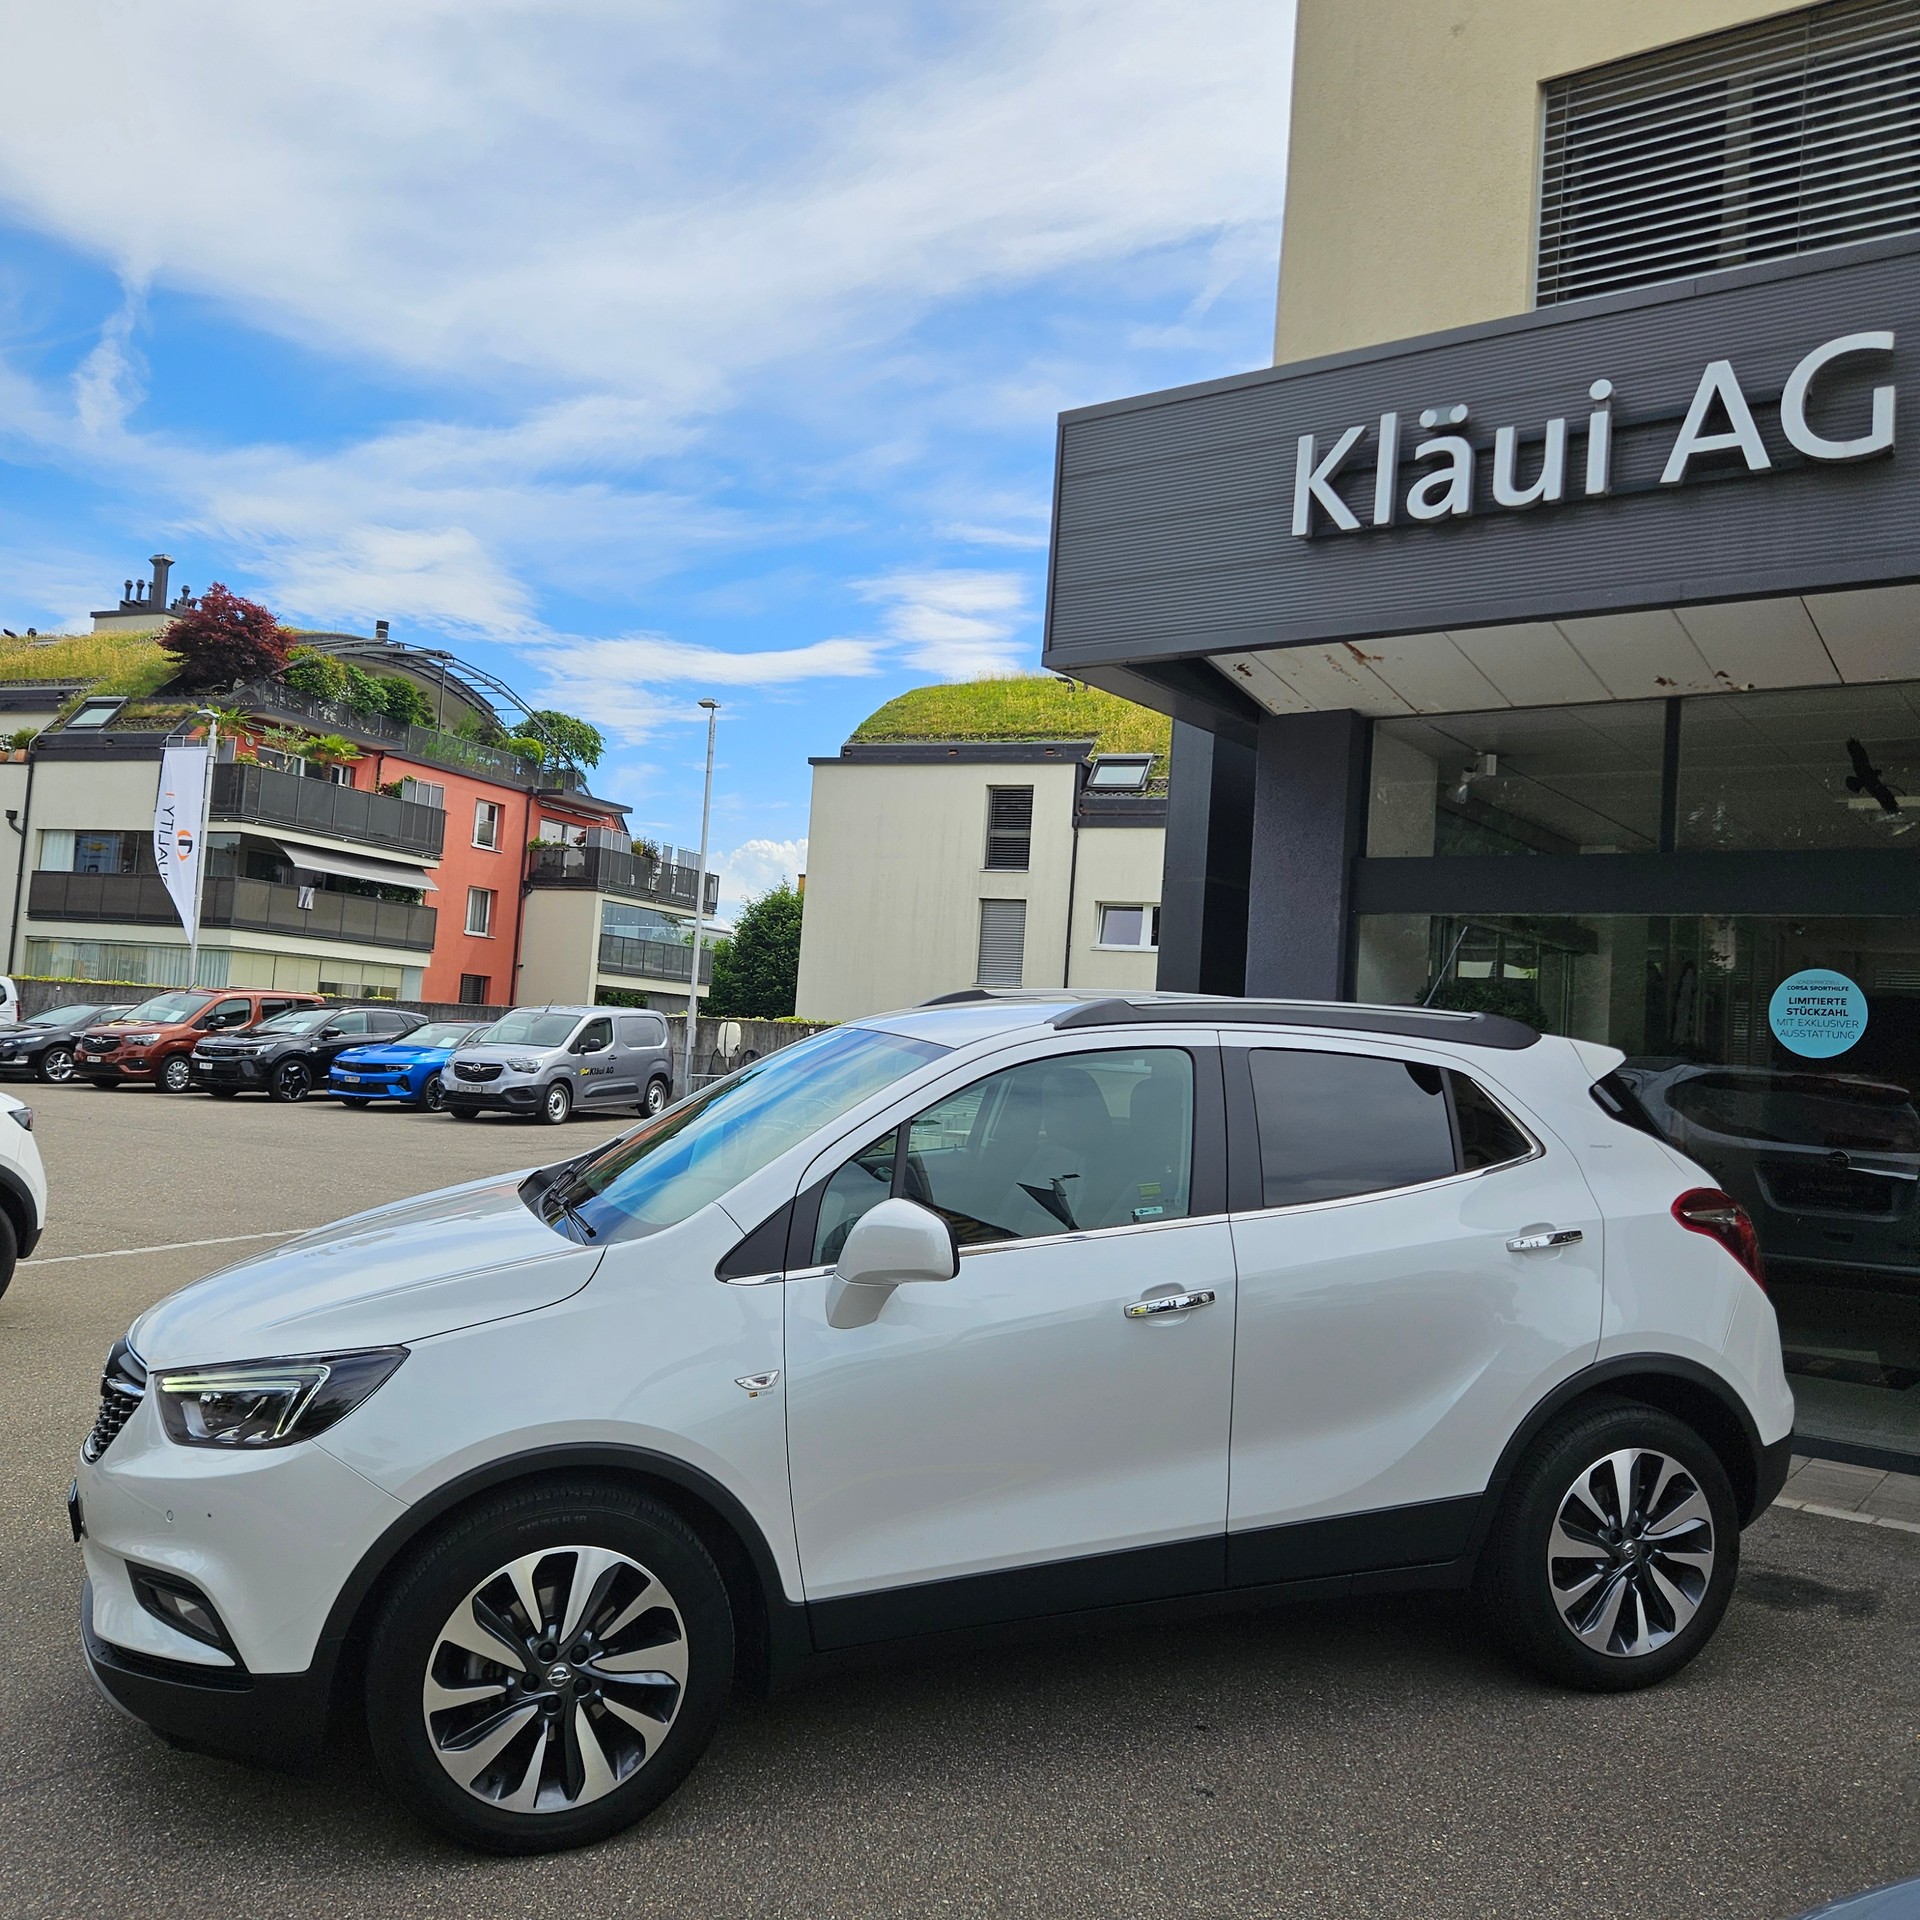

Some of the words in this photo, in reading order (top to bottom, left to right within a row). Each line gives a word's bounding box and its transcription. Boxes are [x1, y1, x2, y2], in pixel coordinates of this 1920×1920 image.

[1291, 378, 1613, 539] Kläui
[1660, 330, 1897, 486] AG
[1789, 997, 1847, 1006] LIMITIERTE
[1786, 1006, 1849, 1017] STÜCKZAHL
[1777, 1018, 1795, 1027] MIT
[1798, 1019, 1859, 1029] EXKLUSIVER
[1780, 1029, 1855, 1040] AUSSTATTUNG
[605, 1066, 614, 1074] AG
